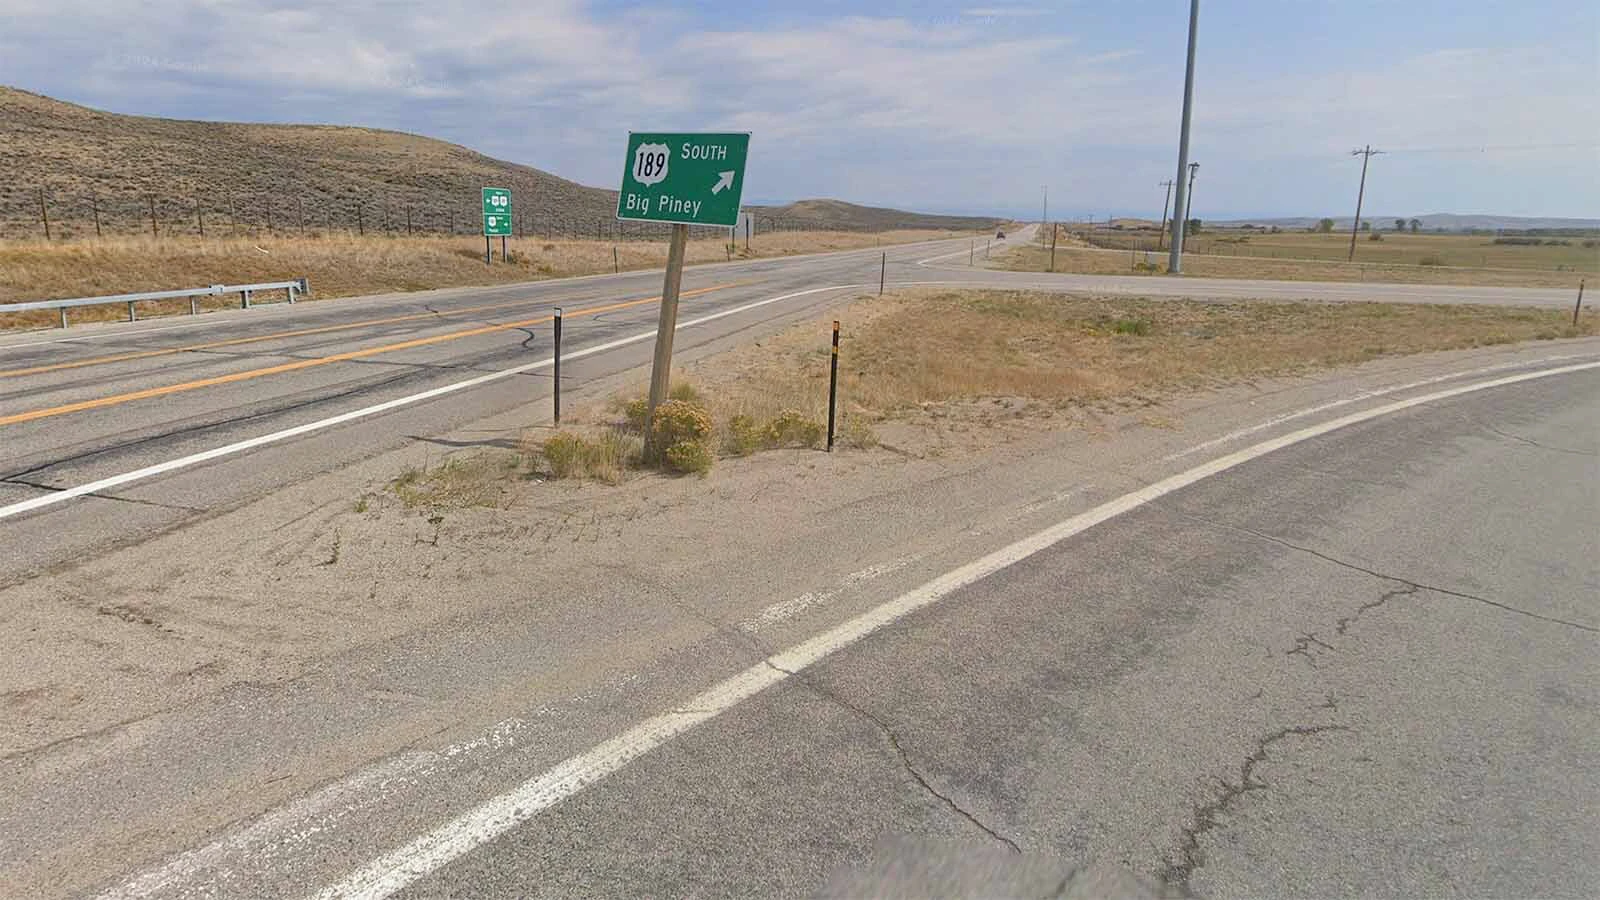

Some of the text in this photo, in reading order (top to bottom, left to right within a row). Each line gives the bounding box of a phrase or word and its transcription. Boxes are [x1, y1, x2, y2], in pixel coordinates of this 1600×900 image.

[681, 143, 727, 160] SOUTH
[637, 152, 665, 177] 189
[626, 193, 702, 218] Big Piney
